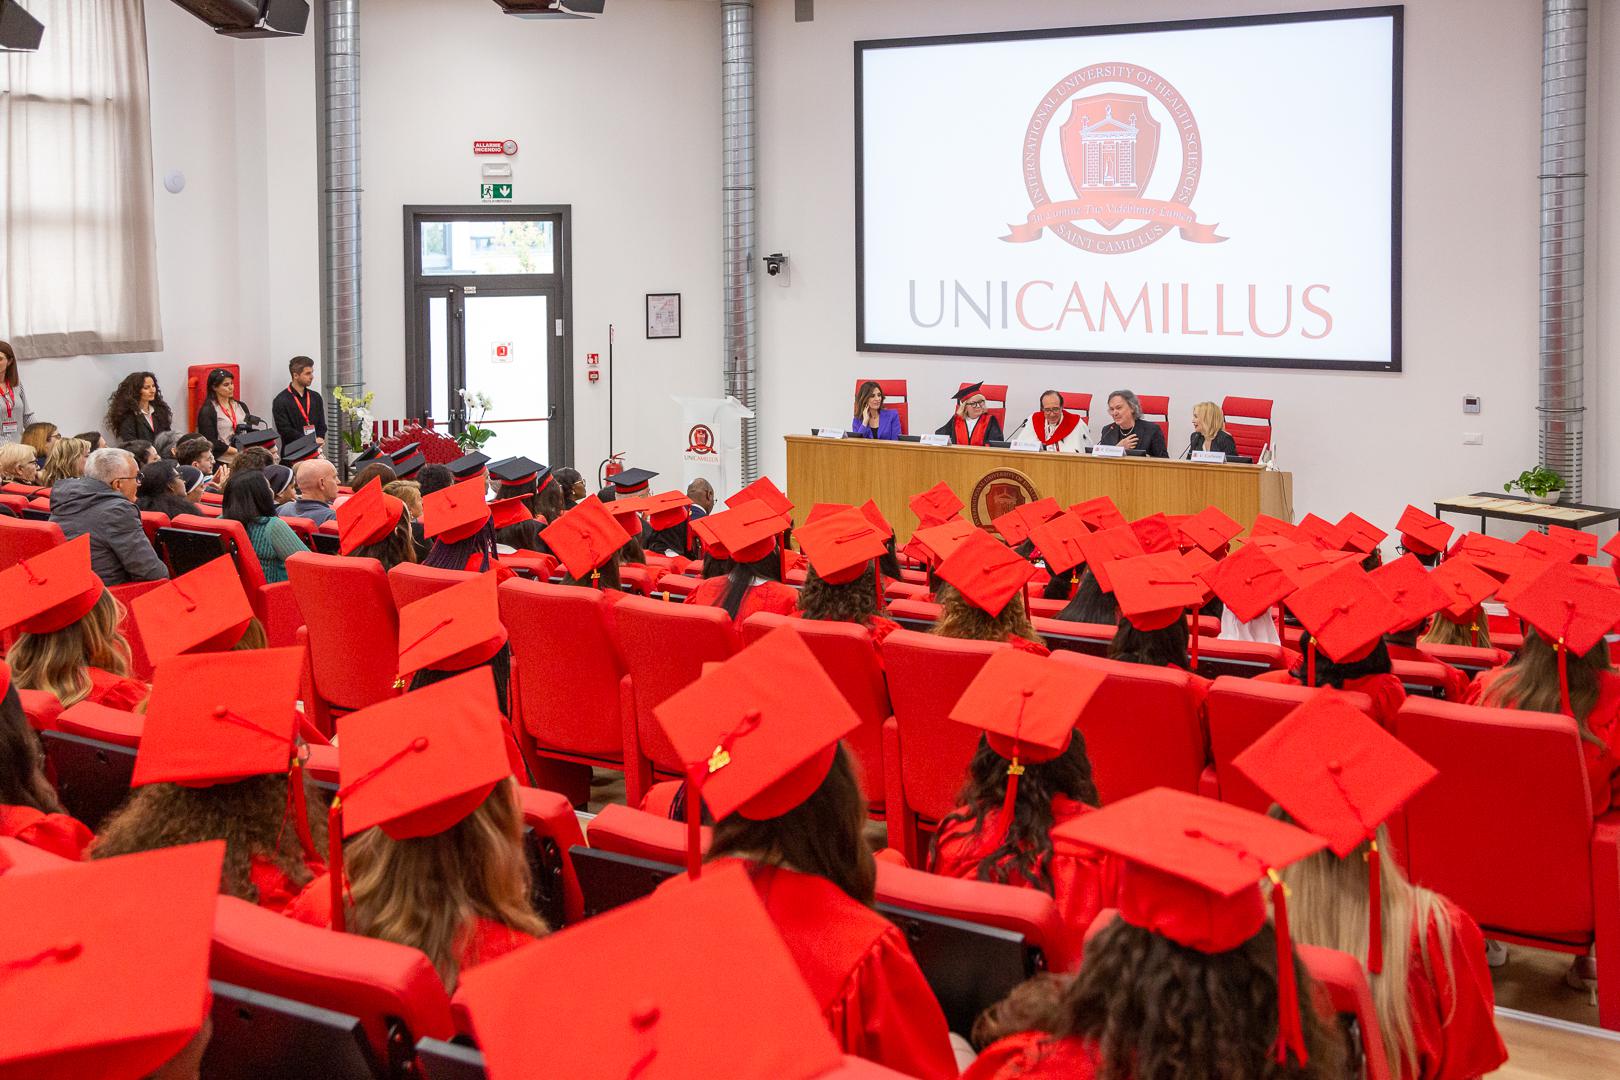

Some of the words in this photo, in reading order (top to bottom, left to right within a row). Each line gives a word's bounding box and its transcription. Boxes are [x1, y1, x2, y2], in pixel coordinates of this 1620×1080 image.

[1024, 97, 1058, 204] INTERNATIONAL
[1056, 65, 1135, 97] UNIVERSITY
[1136, 70, 1156, 86] OF
[1155, 81, 1193, 134] HEALTH
[1178, 132, 1199, 203] SCIENCES
[1055, 223, 1095, 249] SAINT
[1096, 224, 1165, 253] CAMILLUS
[908, 279, 1334, 340] UNICAMILLUS
